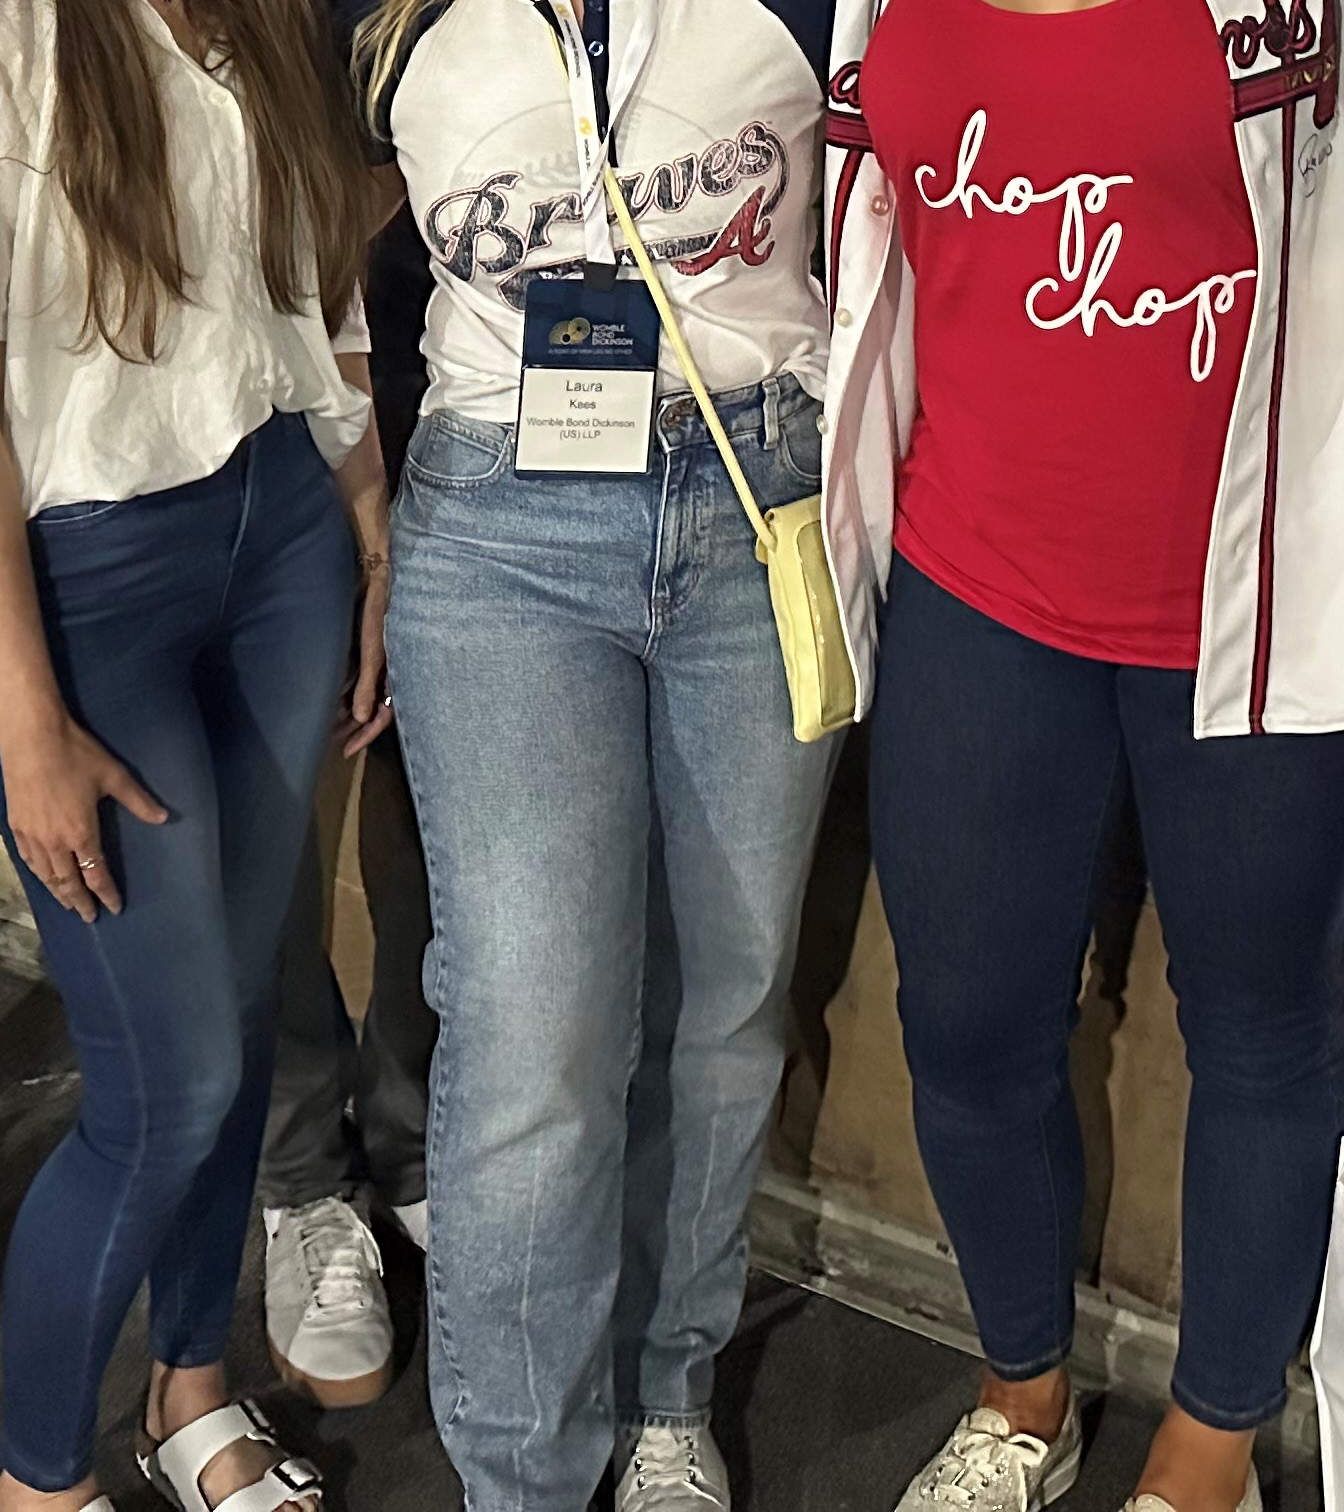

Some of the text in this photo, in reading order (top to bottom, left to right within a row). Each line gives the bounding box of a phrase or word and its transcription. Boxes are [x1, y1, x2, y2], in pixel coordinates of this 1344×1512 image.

[565, 380, 604, 393] Laura
[526, 417, 635, 428] Womble Bond Dickinson
[582, 430, 601, 439] LLP
